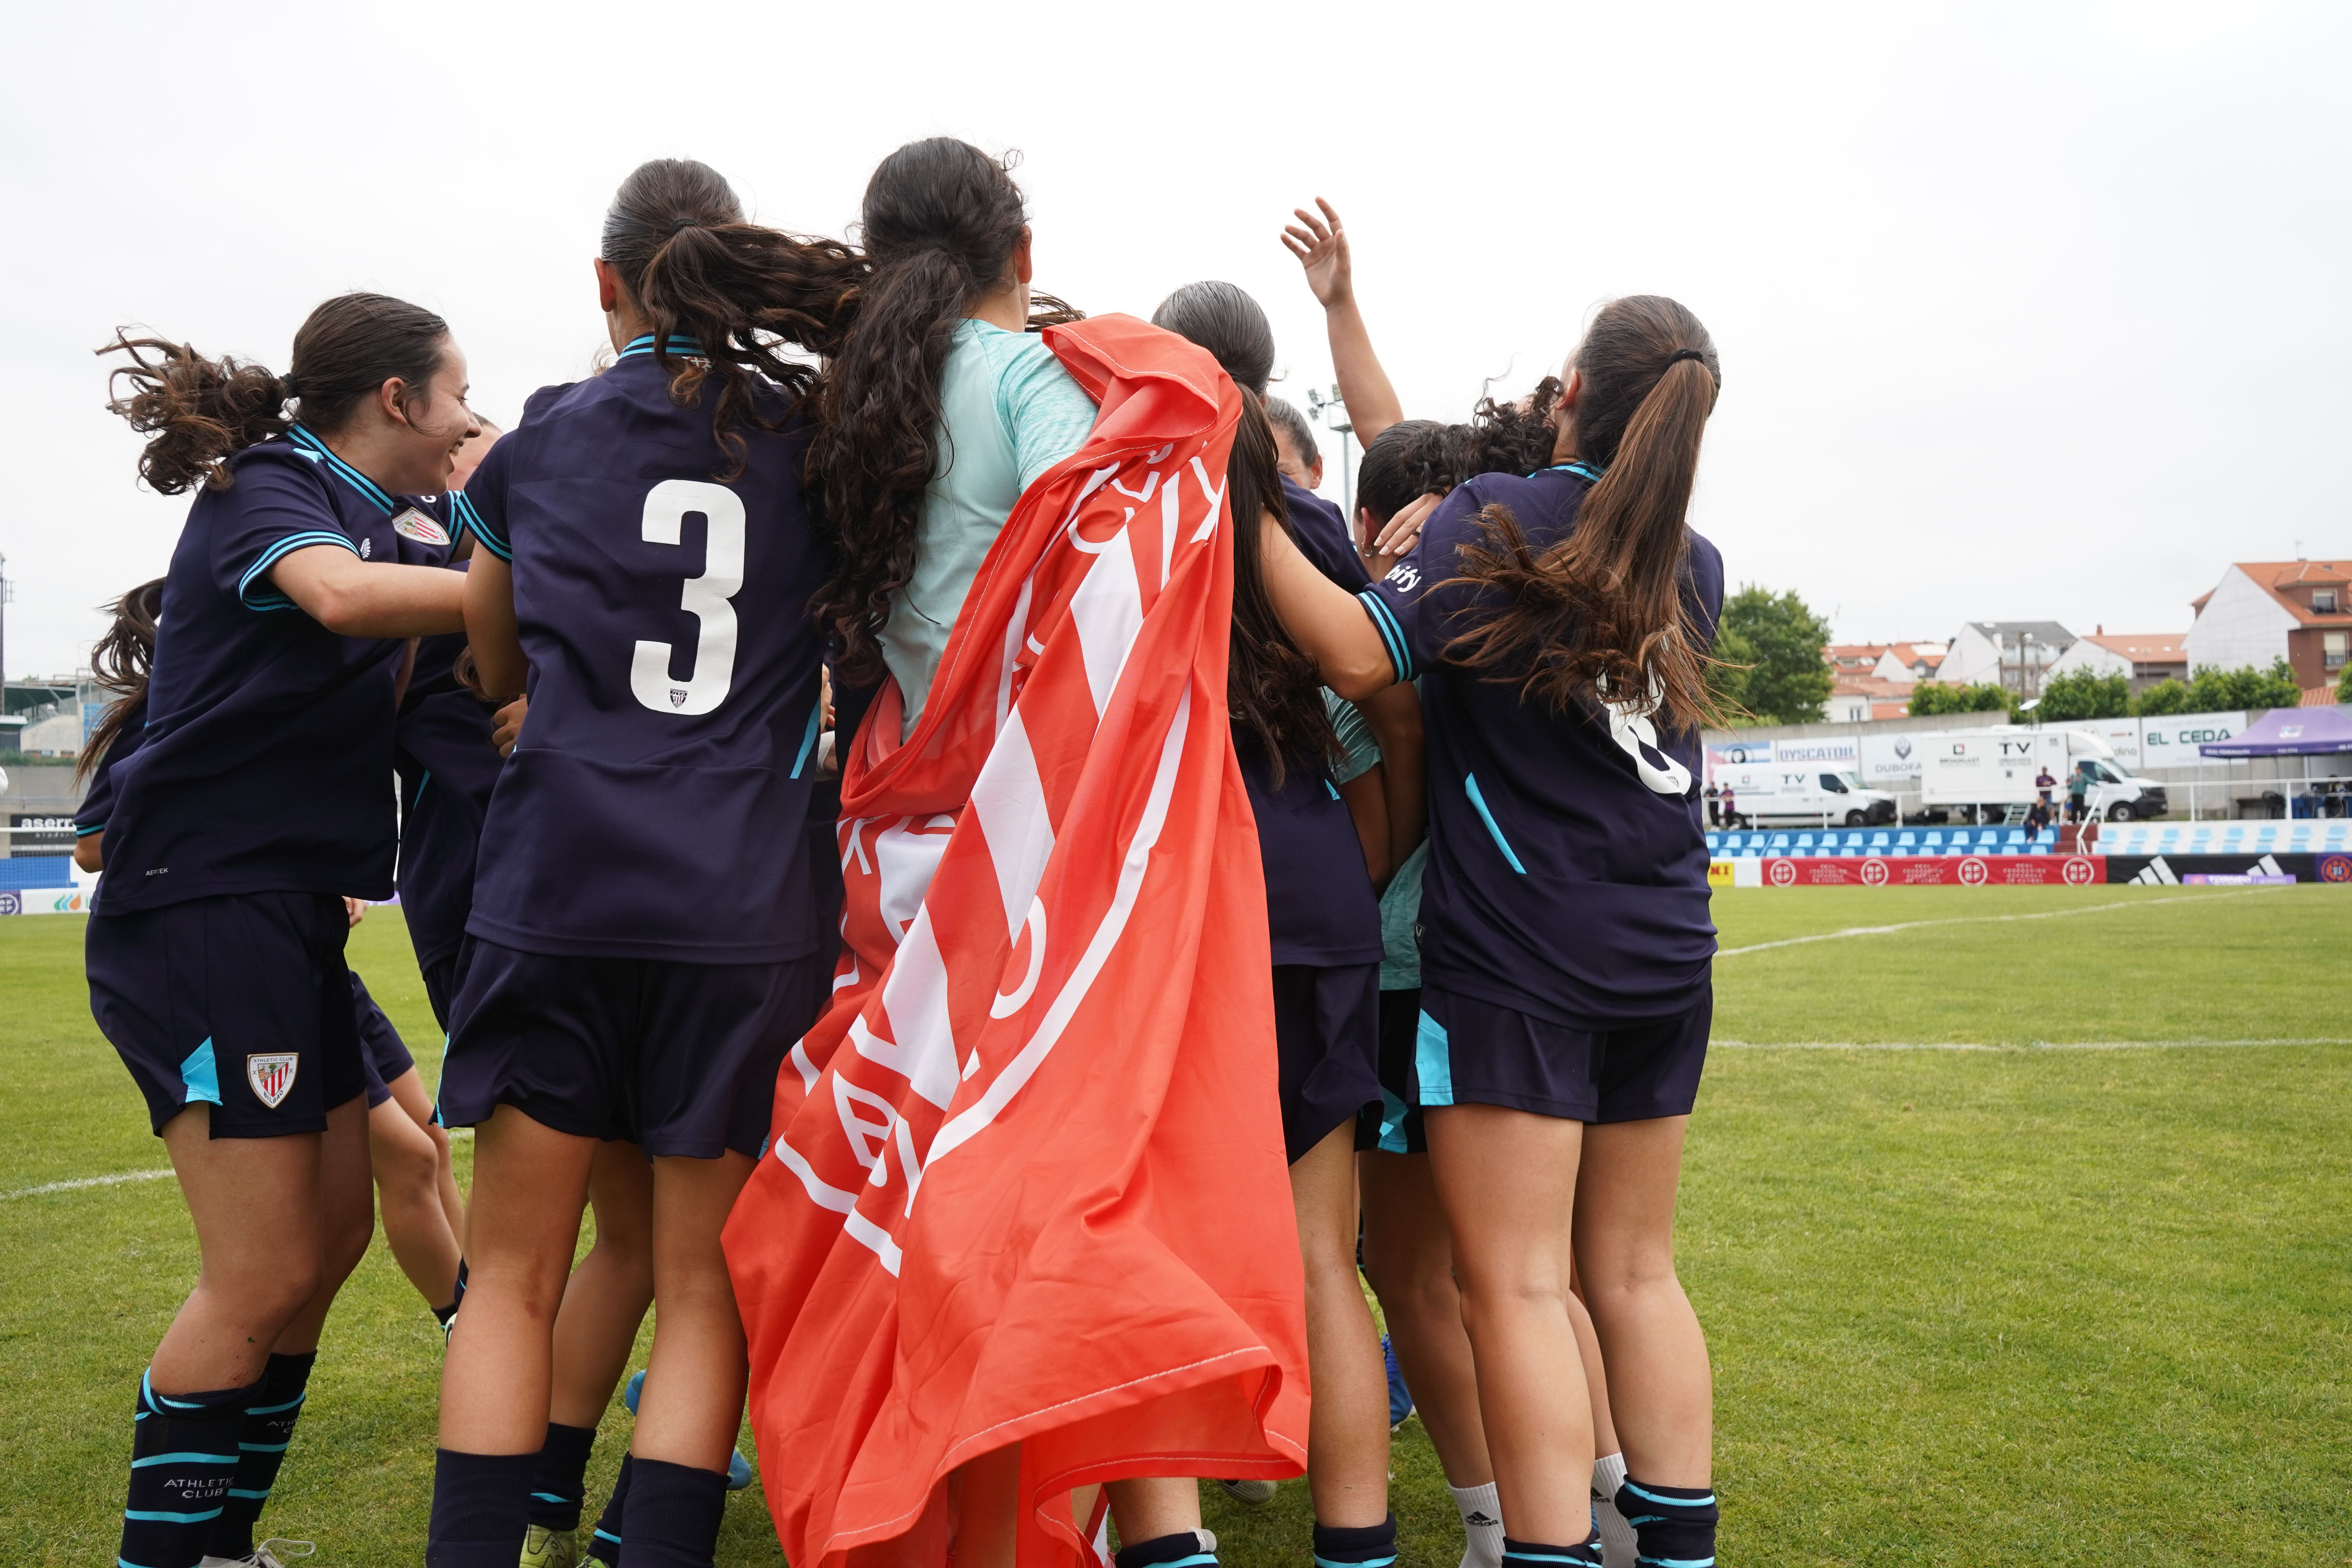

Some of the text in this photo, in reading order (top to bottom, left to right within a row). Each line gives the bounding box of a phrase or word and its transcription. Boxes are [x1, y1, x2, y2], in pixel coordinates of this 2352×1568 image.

[630, 479, 746, 715] 3
[2147, 732, 2169, 745] EL
[1780, 746, 1855, 760] DYSCATOIL
[1998, 742, 2030, 755] TV
[1781, 774, 1806, 784] TV
[145, 867, 169, 876] AERTEK
[264, 1090, 283, 1103] BILBAO
[164, 1477, 234, 1488] ATHLETIC
[182, 1488, 223, 1499] CLUB
